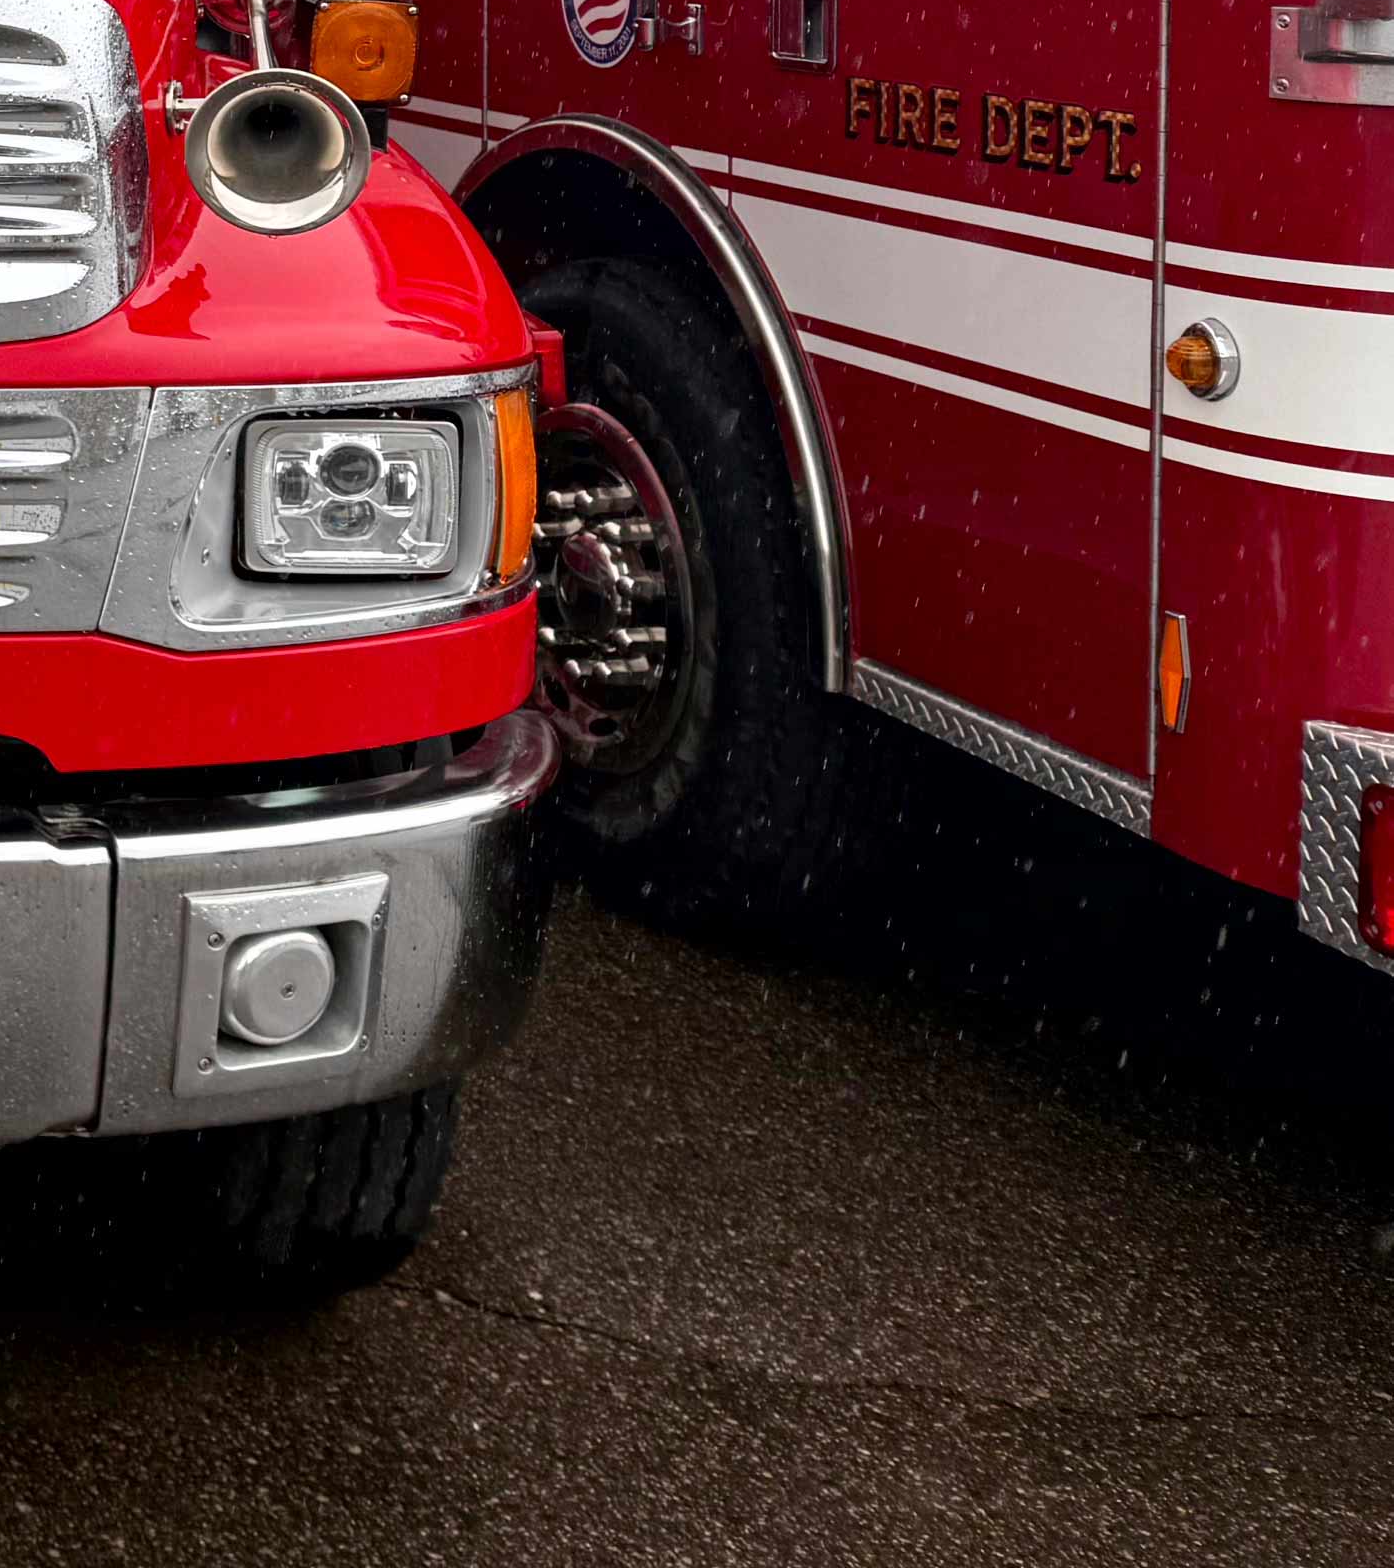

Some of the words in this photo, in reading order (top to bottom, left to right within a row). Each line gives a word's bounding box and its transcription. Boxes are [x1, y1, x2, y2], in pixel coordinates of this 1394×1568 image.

[571, 18, 607, 60] SEPTEMBER
[847, 77, 961, 155] FIRE
[983, 92, 1142, 183] DEPT.
